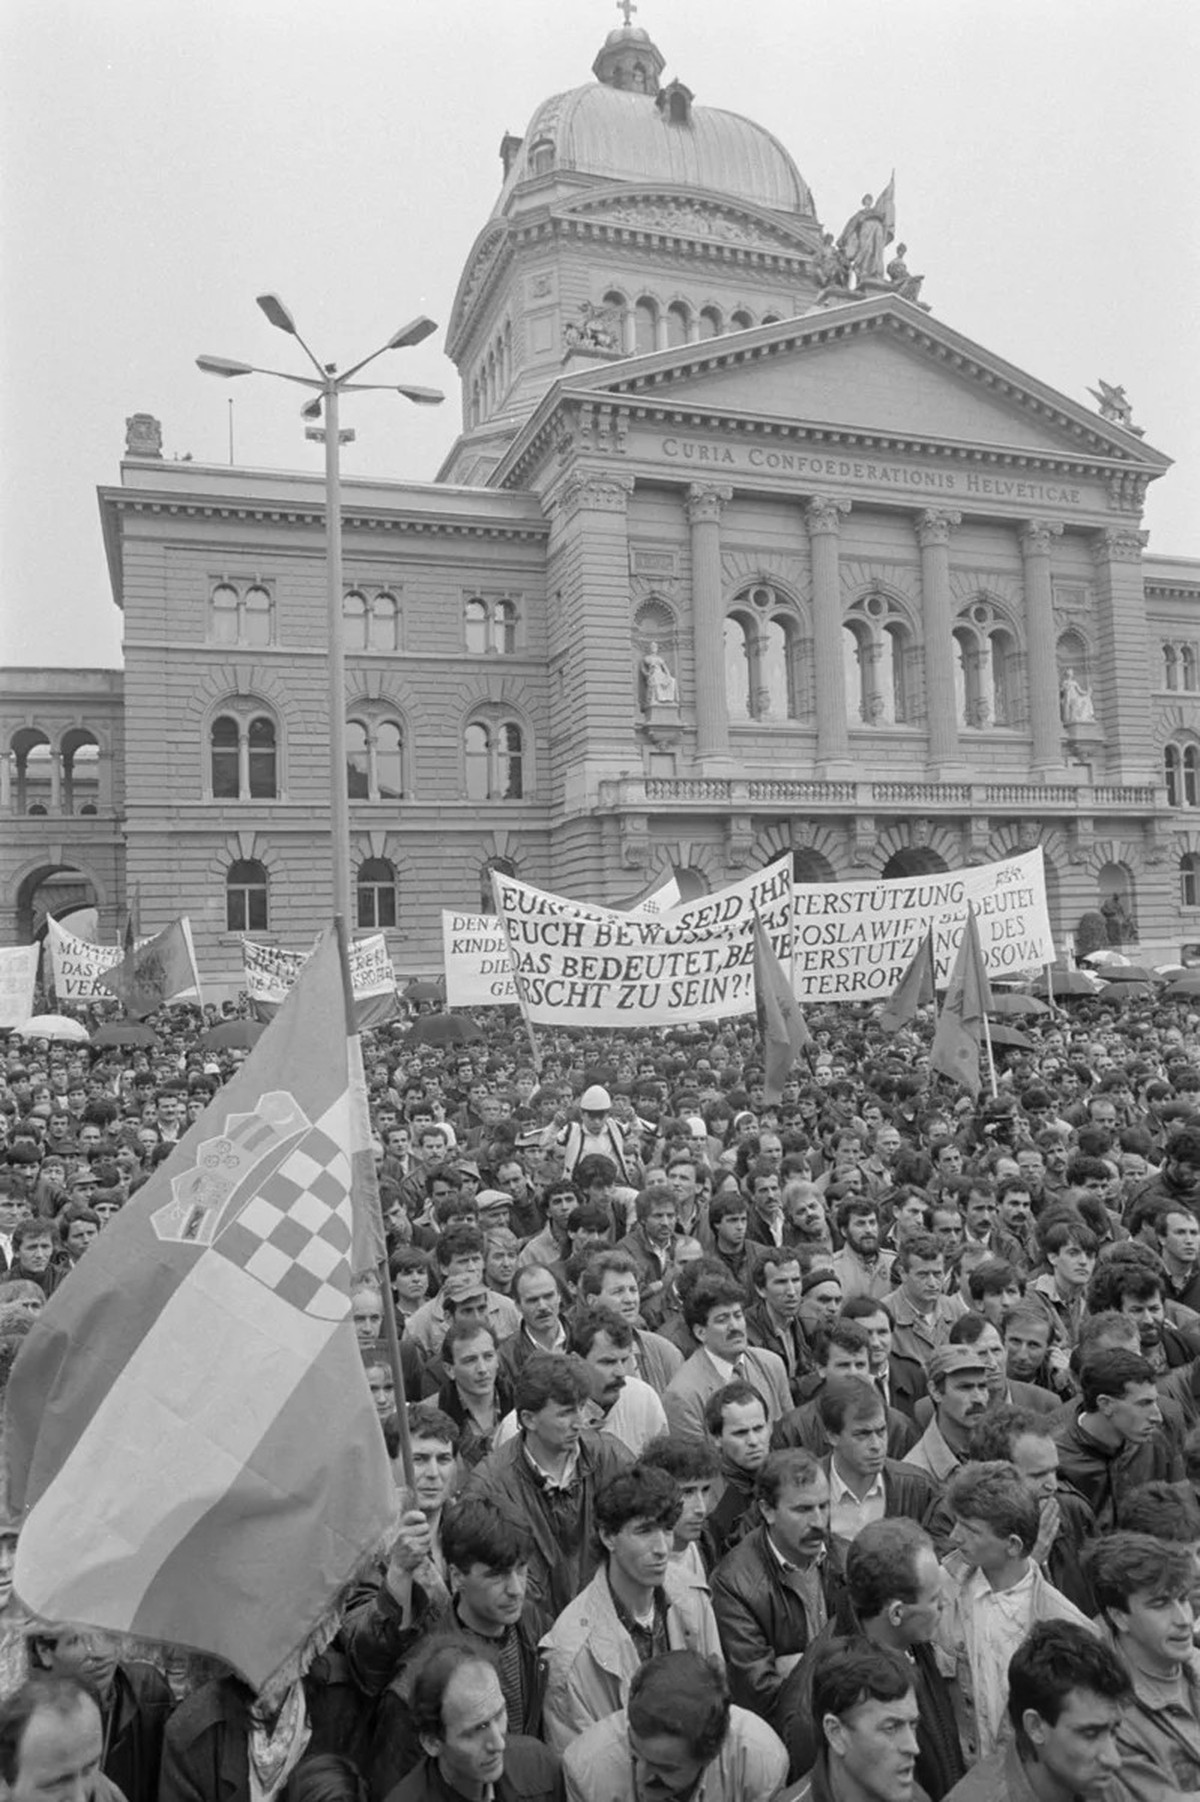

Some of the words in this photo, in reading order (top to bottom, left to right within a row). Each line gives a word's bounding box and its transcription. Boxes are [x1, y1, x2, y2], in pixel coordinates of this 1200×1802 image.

[662, 438, 736, 464] CURIA
[748, 448, 955, 489] CONFOEDERATIONIS
[967, 473, 1081, 504] HELVETICAE
[451, 917, 488, 931] DEN
[675, 895, 743, 931] SEID
[991, 915, 1026, 941] DES
[506, 917, 586, 948] EUCH
[61, 961, 95, 977] DAS
[616, 982, 661, 1009] ZU
[668, 972, 752, 1009] SEIN?!
